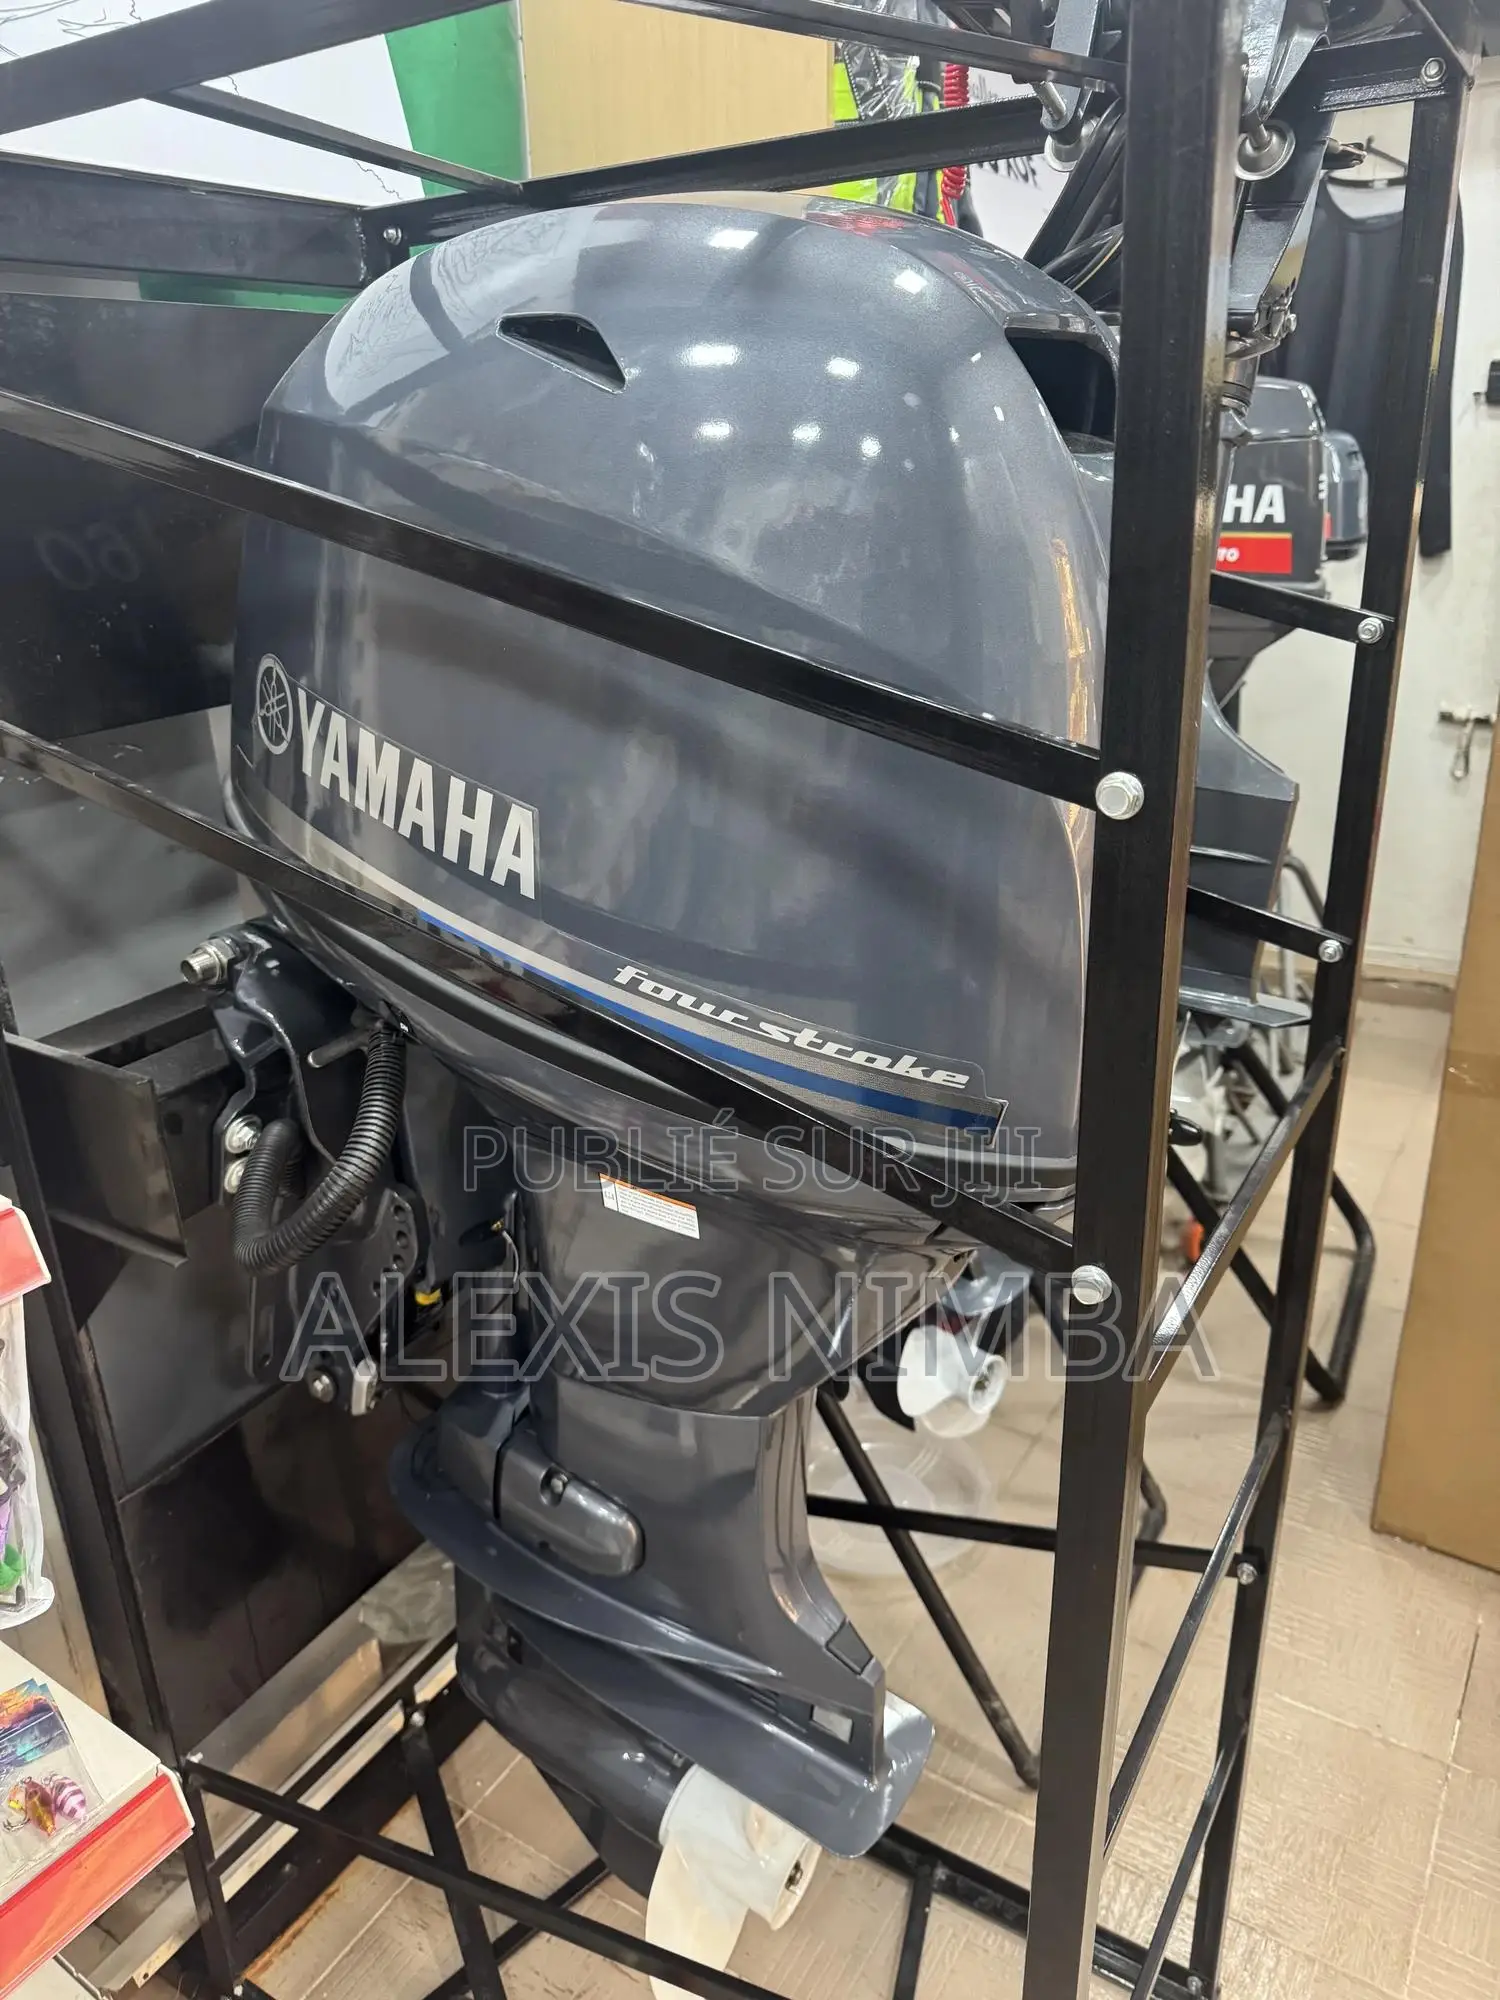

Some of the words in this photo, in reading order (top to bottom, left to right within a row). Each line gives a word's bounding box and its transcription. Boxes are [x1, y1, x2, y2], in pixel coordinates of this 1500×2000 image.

[1221, 484, 1286, 523] HA
[297, 687, 536, 900] YAMAHA
[613, 965, 749, 1025] four
